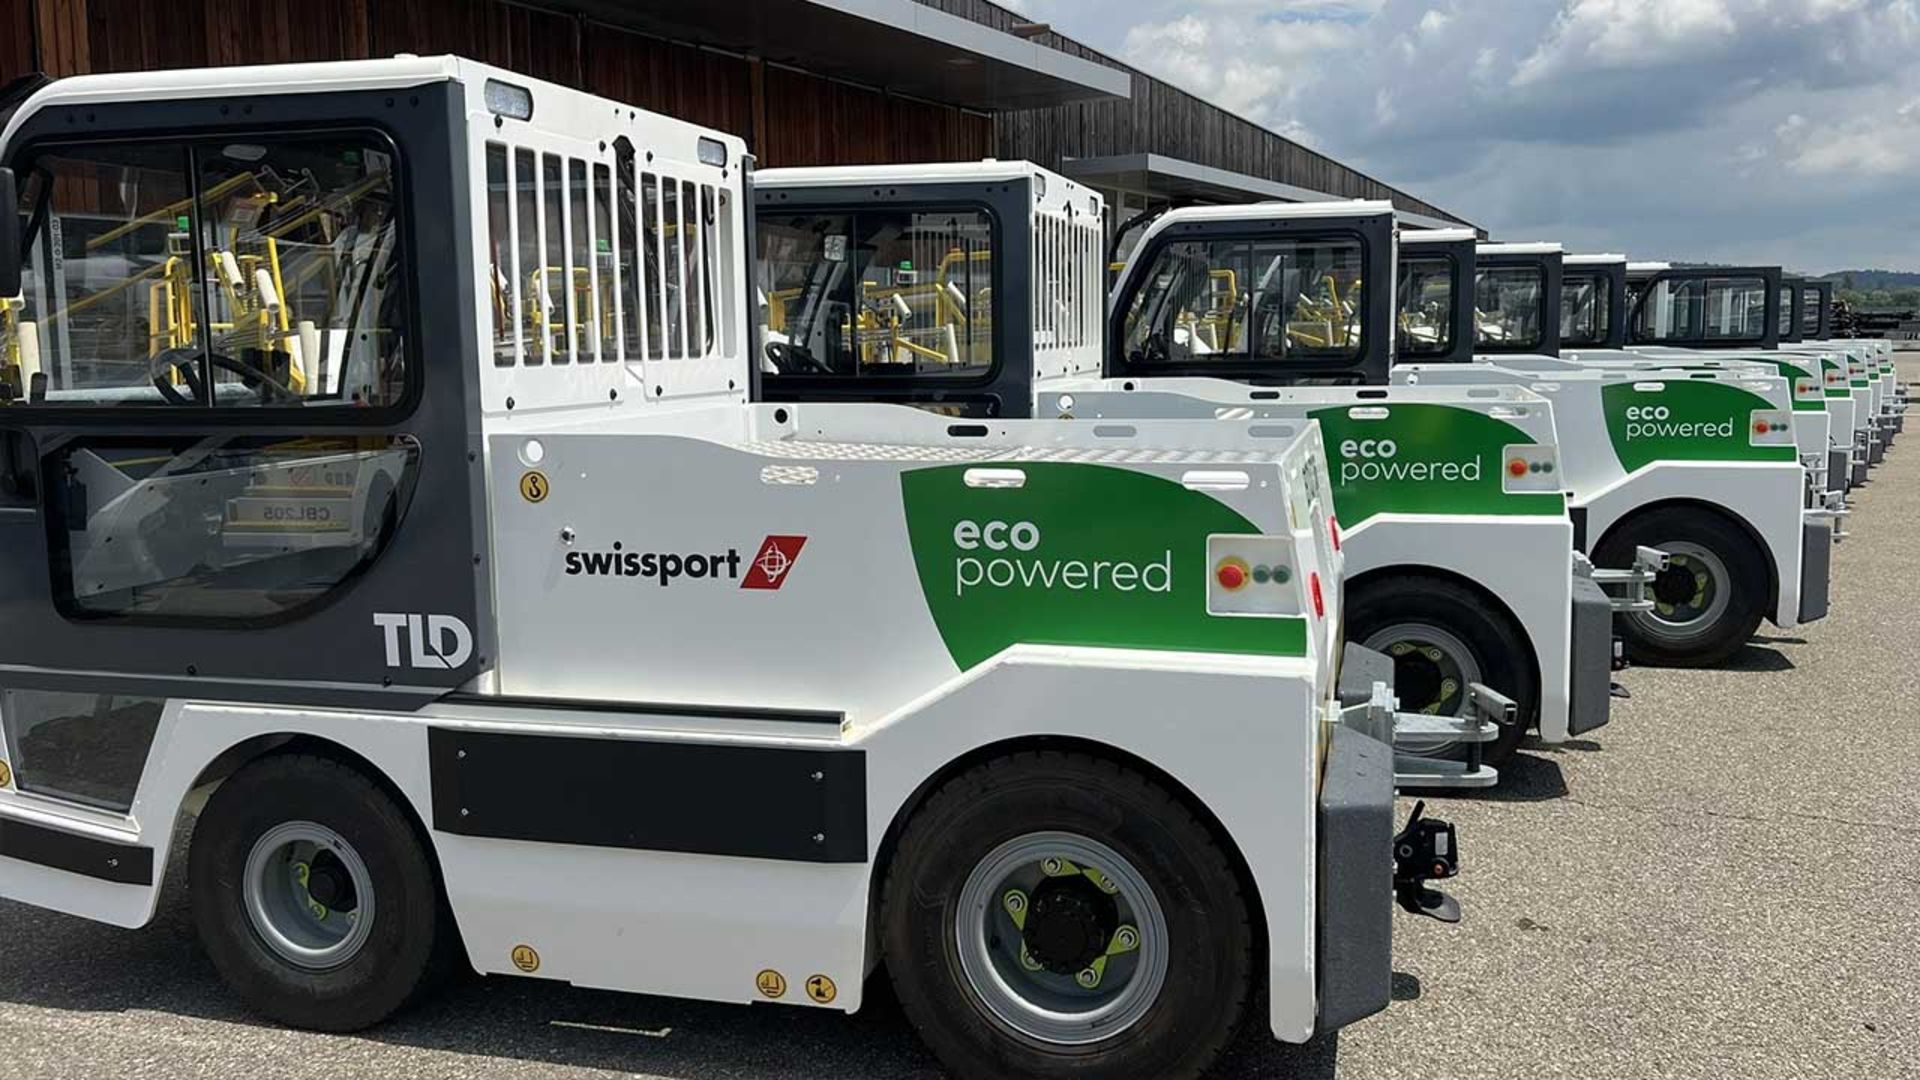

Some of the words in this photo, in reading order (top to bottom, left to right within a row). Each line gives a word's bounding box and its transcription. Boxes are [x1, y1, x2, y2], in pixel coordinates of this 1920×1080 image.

[1626, 405, 1670, 421] eco
[1626, 417, 1734, 441] powered
[1340, 439, 1397, 458] eco
[1341, 455, 1481, 486] powered
[953, 519, 1039, 552] eco
[565, 541, 740, 587] swissport
[956, 550, 1172, 596] powered
[372, 612, 474, 670] TLD
